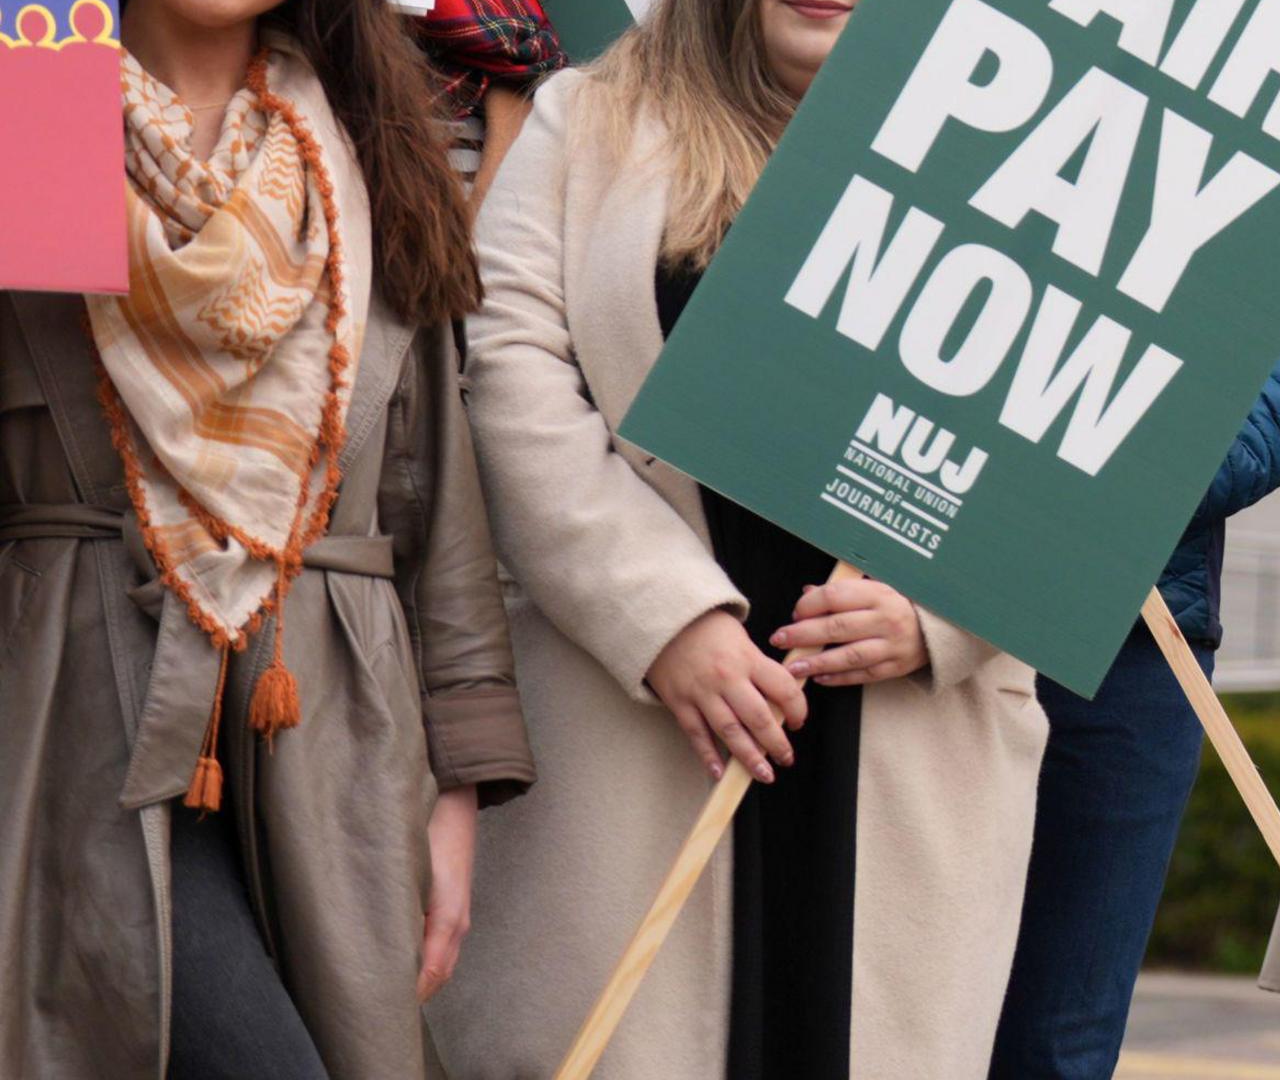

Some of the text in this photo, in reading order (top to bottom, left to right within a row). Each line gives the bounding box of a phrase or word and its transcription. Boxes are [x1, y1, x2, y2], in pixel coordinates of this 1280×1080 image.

[783, 174, 1184, 477] NOW
[854, 392, 990, 494] NUJ
[826, 478, 941, 550] JOURNALISTS
[843, 446, 959, 519] NATIONAL UNION
[884, 489, 902, 505] OF
